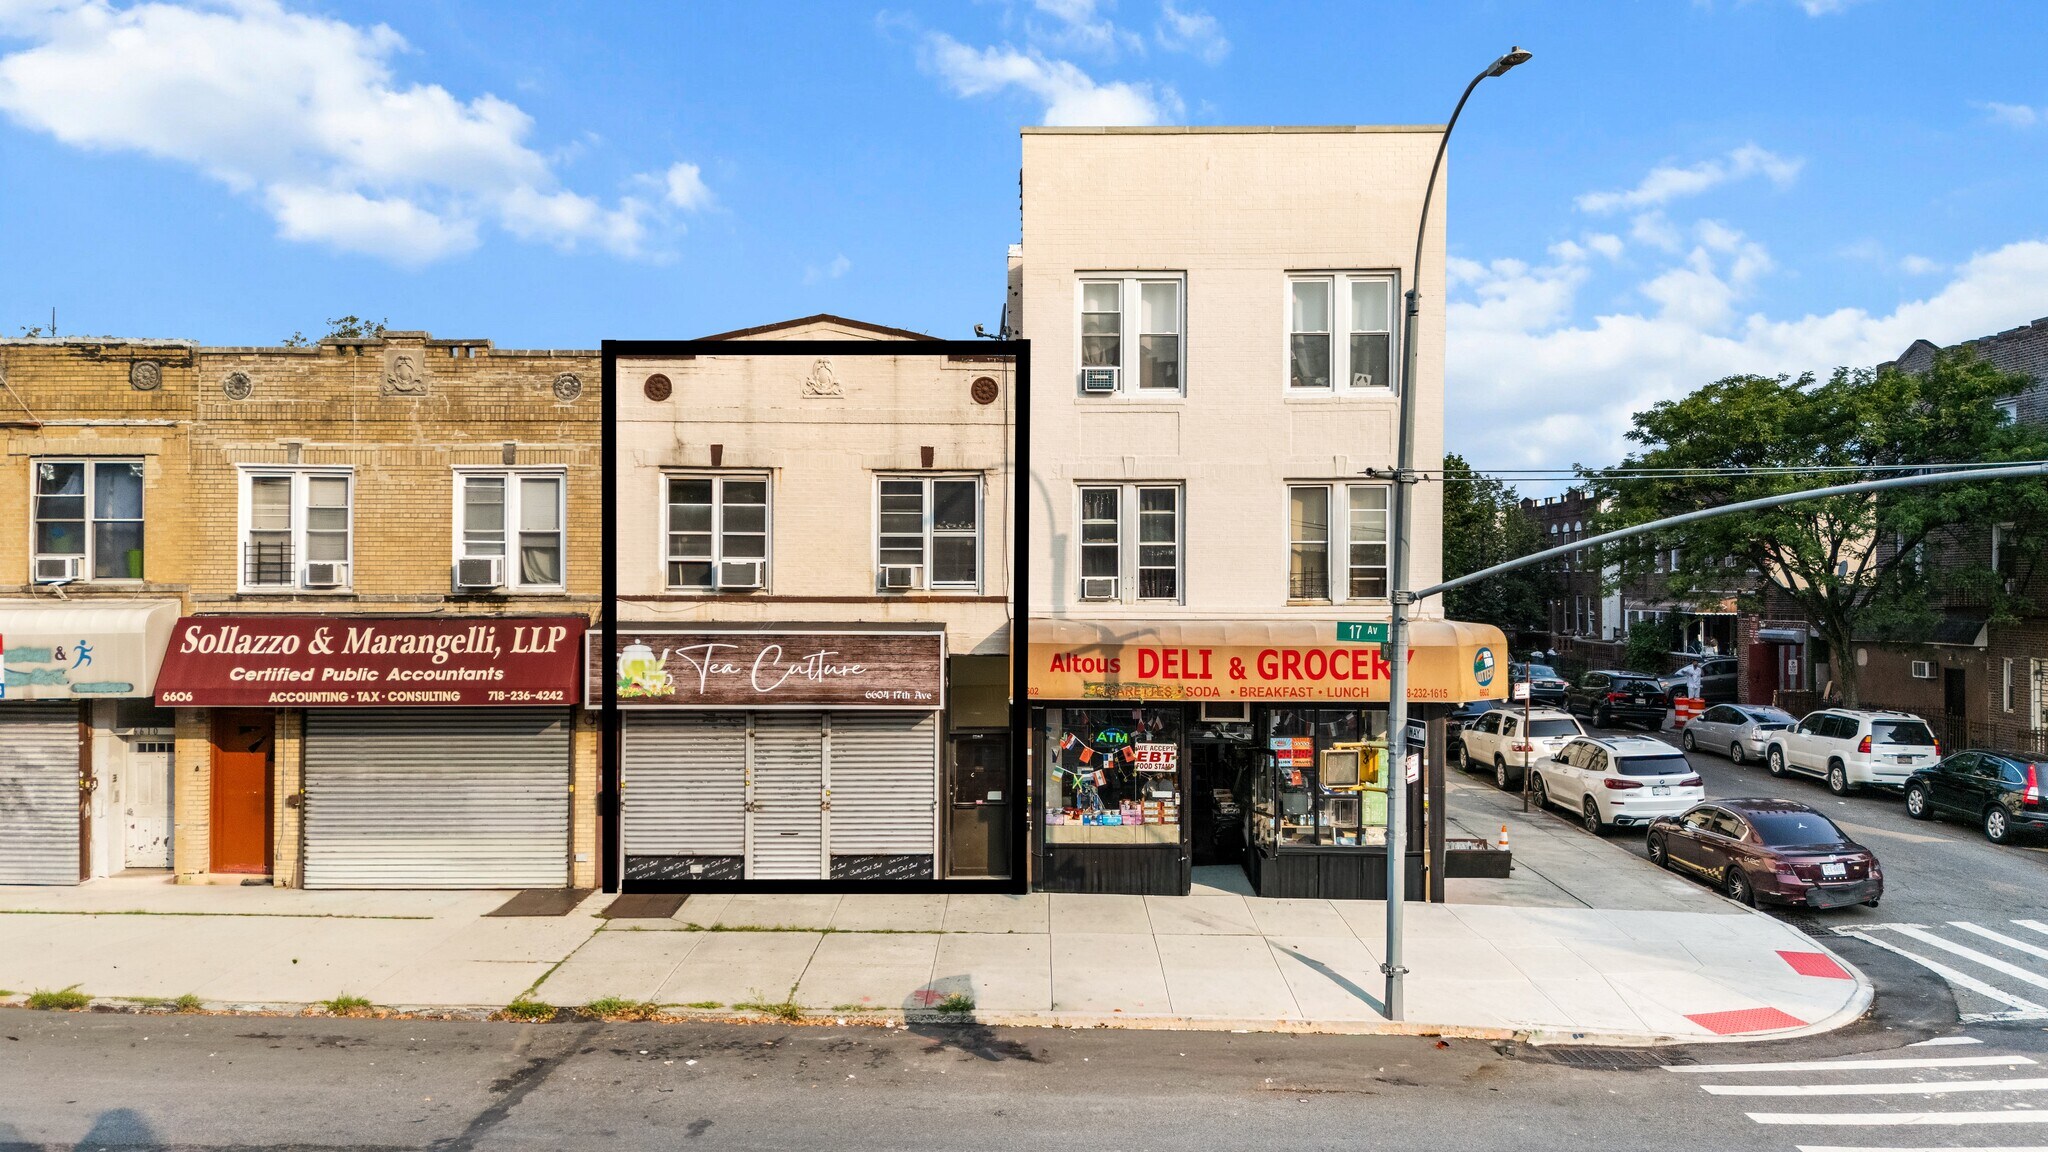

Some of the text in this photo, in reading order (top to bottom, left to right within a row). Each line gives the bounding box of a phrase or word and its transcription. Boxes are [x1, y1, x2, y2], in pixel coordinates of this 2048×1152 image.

[1349, 624, 1378, 639] 17 Av
[180, 625, 567, 664] Sollazzo & Marangelli, LLP
[54, 645, 67, 661] &
[675, 643, 867, 694] Tea Culture
[1049, 652, 1121, 673] Altous
[1138, 648, 1213, 680] DELI
[1229, 656, 1248, 680] &
[1257, 648, 1415, 681] GROCER
[229, 666, 505, 682] Certified Public Accountants
[162, 691, 193, 702] 6606
[268, 691, 461, 703] ACCOUNTING TAX CONSULTING
[487, 691, 564, 701] 718-236-4242
[865, 690, 932, 700] 6604 17th Ave
[1185, 686, 1221, 698] SODA
[1239, 686, 1314, 698] BREAKFAST
[1327, 686, 1369, 698] LUNCH
[1096, 731, 1128, 743] ATM
[1136, 751, 1174, 763] EBT
